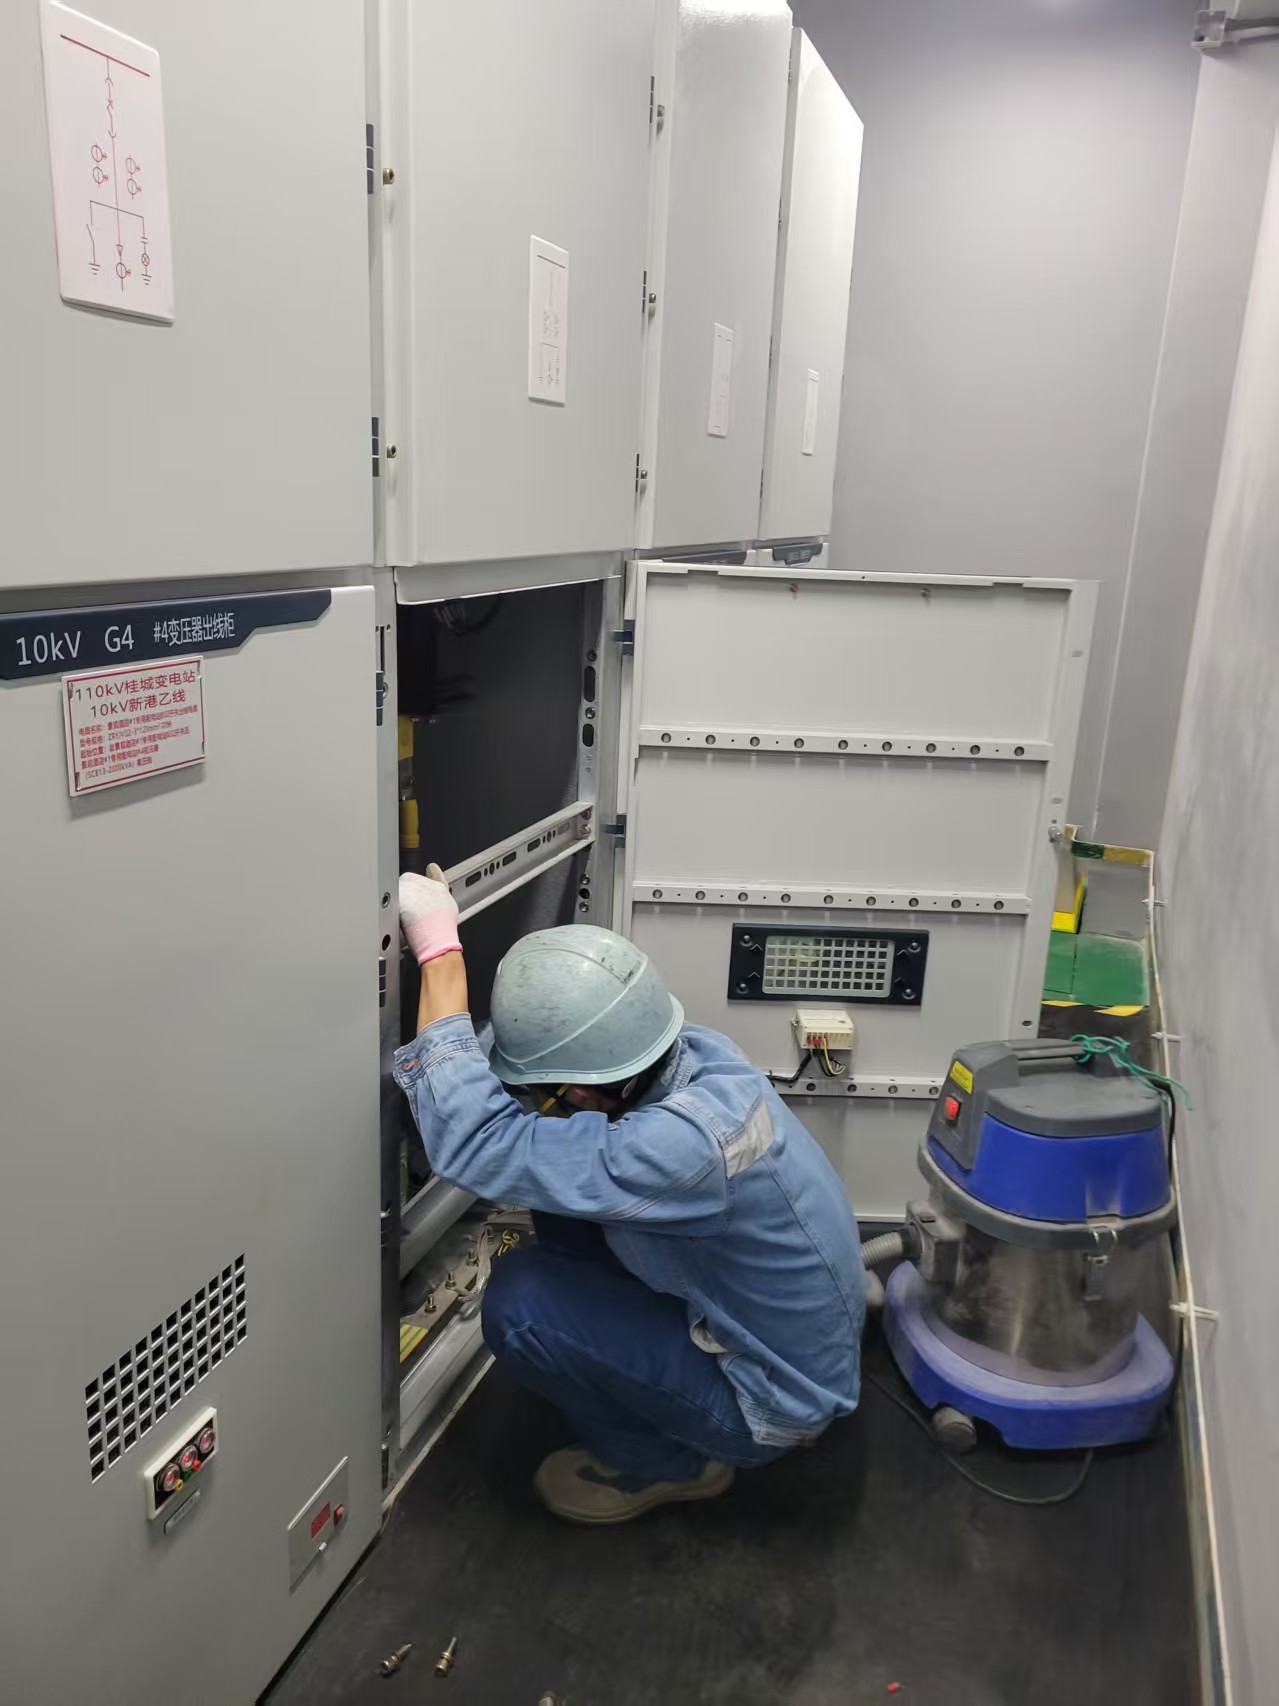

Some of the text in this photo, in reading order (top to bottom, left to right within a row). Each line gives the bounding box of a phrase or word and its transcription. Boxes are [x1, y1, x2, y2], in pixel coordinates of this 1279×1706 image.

[16, 612, 235, 666] 10kV G4 #4变压器出线柜
[76, 670, 196, 701] 110kV桂城变电站
[90, 689, 185, 718] 10kV新港乙线
